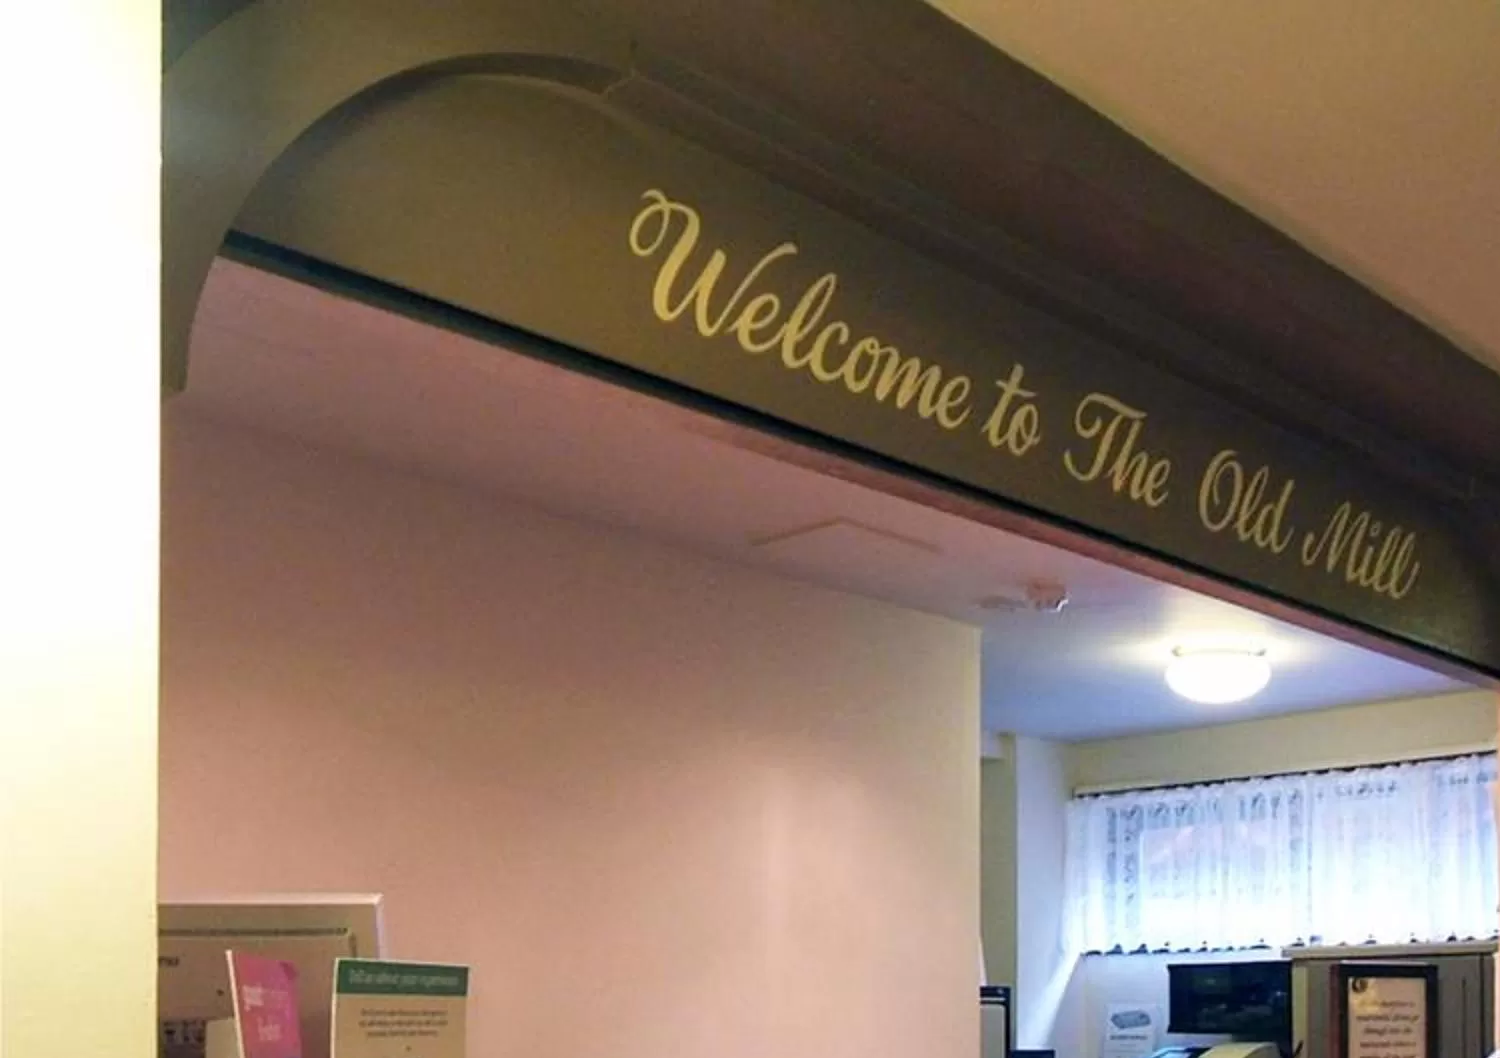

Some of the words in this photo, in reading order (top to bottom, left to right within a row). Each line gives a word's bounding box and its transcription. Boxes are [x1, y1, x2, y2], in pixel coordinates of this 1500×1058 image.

[629, 188, 974, 428] Welcome
[981, 362, 1042, 456] to
[1064, 392, 1171, 508] The
[1200, 449, 1297, 554] Old
[1303, 502, 1420, 600] Mill
